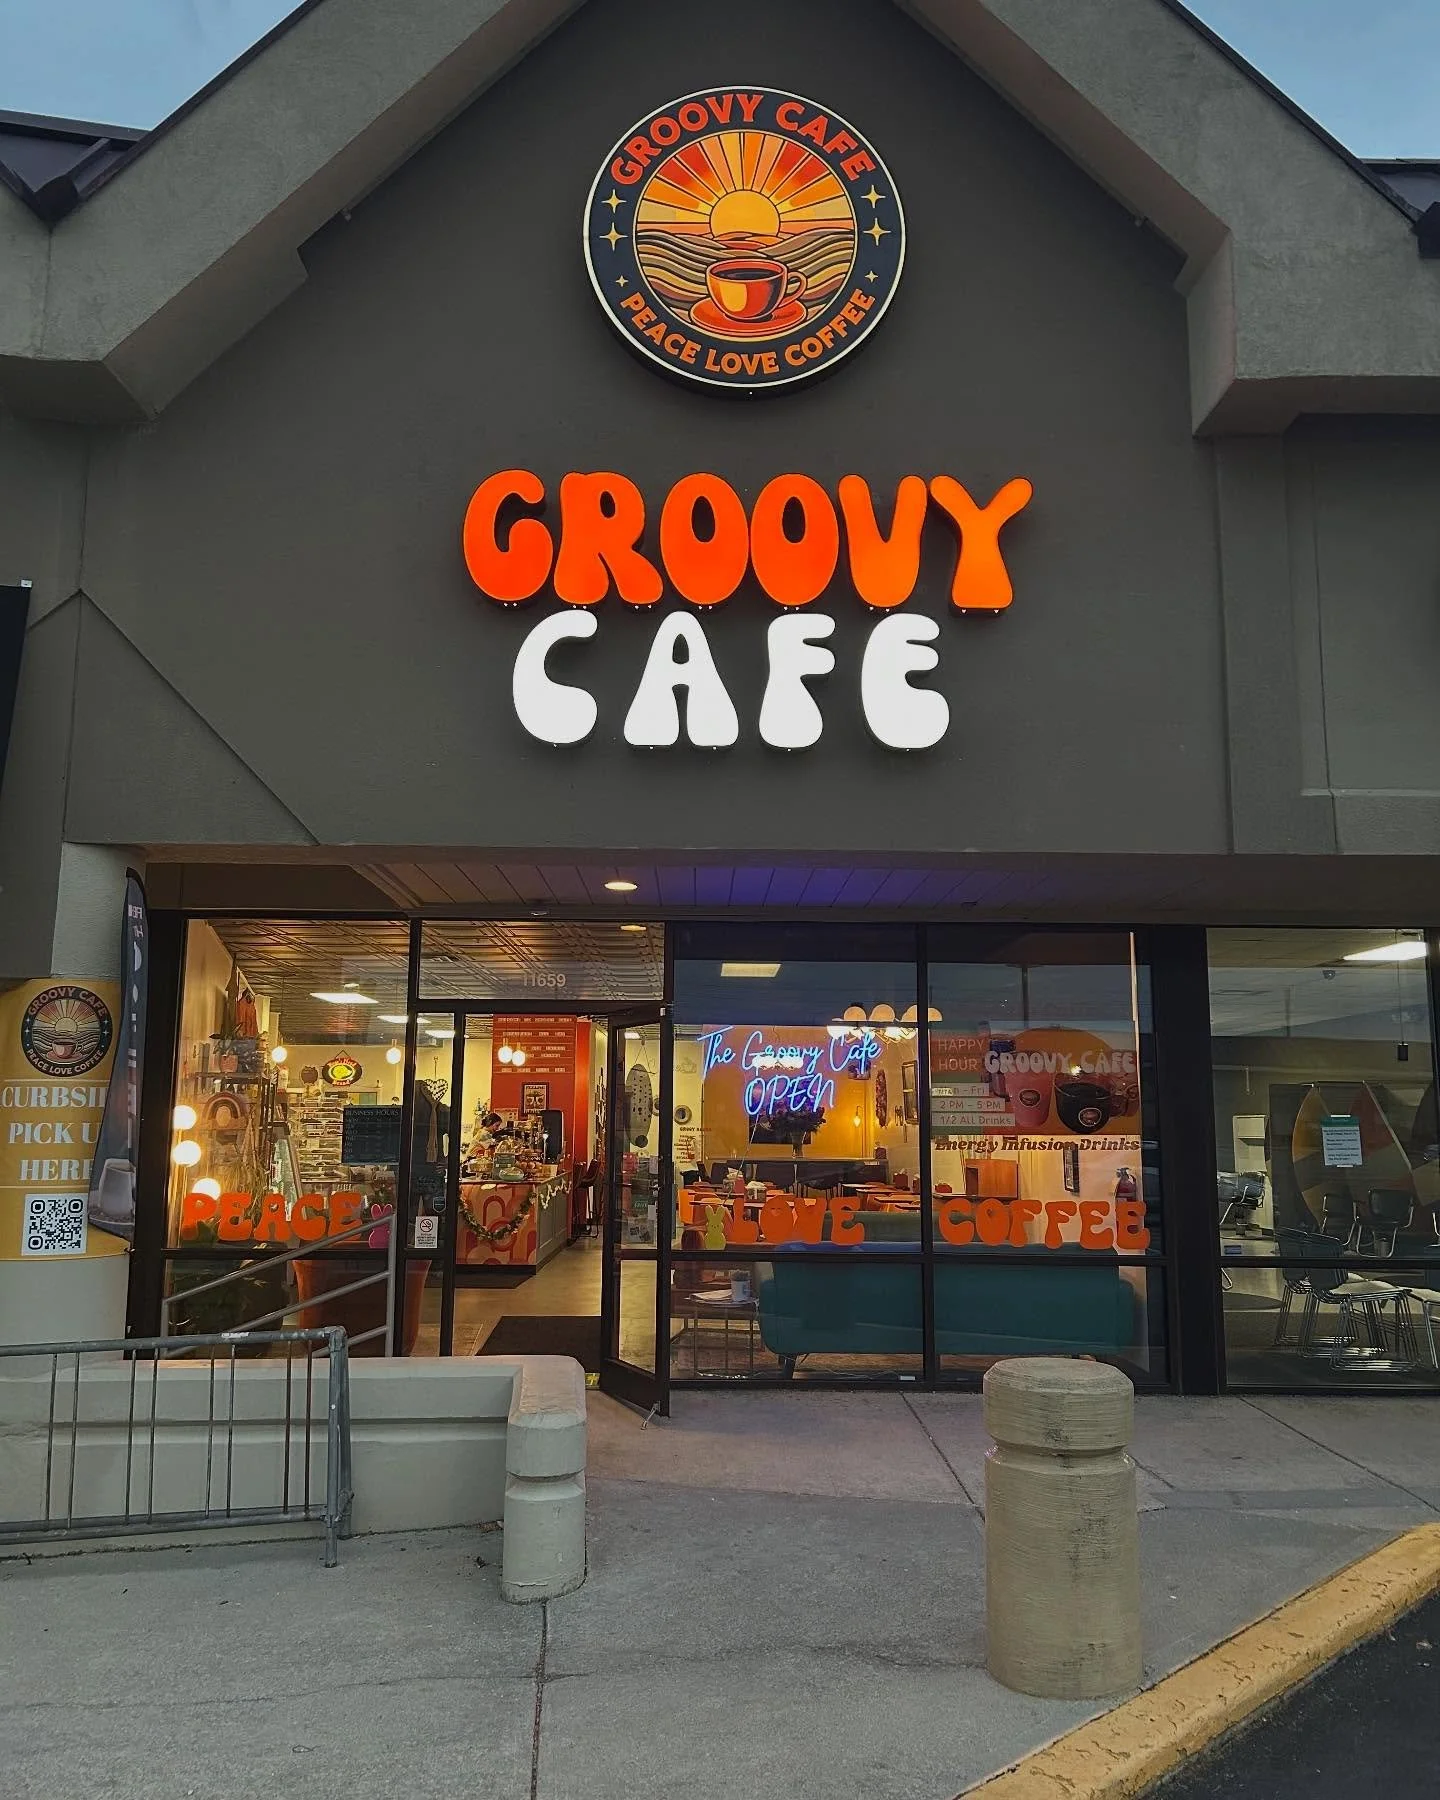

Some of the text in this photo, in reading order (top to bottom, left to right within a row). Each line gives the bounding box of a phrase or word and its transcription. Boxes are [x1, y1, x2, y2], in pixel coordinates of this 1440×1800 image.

[610, 94, 876, 185] GROOVY CAFE
[620, 288, 876, 376] PEACE LOVE COFFEE
[463, 469, 1034, 609] GROOVY
[512, 609, 950, 748] CAFE
[523, 972, 566, 987] 11659
[28, 987, 109, 1017] GROOVY CAFE
[697, 1025, 737, 1082] The
[829, 1030, 882, 1075] Cafe
[938, 1038, 984, 1052] HAPPY
[27, 1048, 104, 1075] PEACE LOVE COFFEE
[938, 1058, 978, 1071] HOUR
[984, 1050, 1136, 1074] GROOVY CAFE
[744, 1072, 835, 1115] OPEN
[940, 1100, 946, 1110] 2
[949, 1100, 964, 1110] PM
[976, 1100, 983, 1110] 5
[986, 1100, 1001, 1110] PM
[8, 1122, 75, 1144] PICK
[940, 1115, 957, 1125] 1/2
[978, 1114, 1012, 1125] Drinks
[934, 1137, 1141, 1153] Energy Infusion Drinks
[182, 1192, 362, 1242] PEACE
[726, 1195, 865, 1246] LOVE
[938, 1198, 1151, 1251] COFFEE
